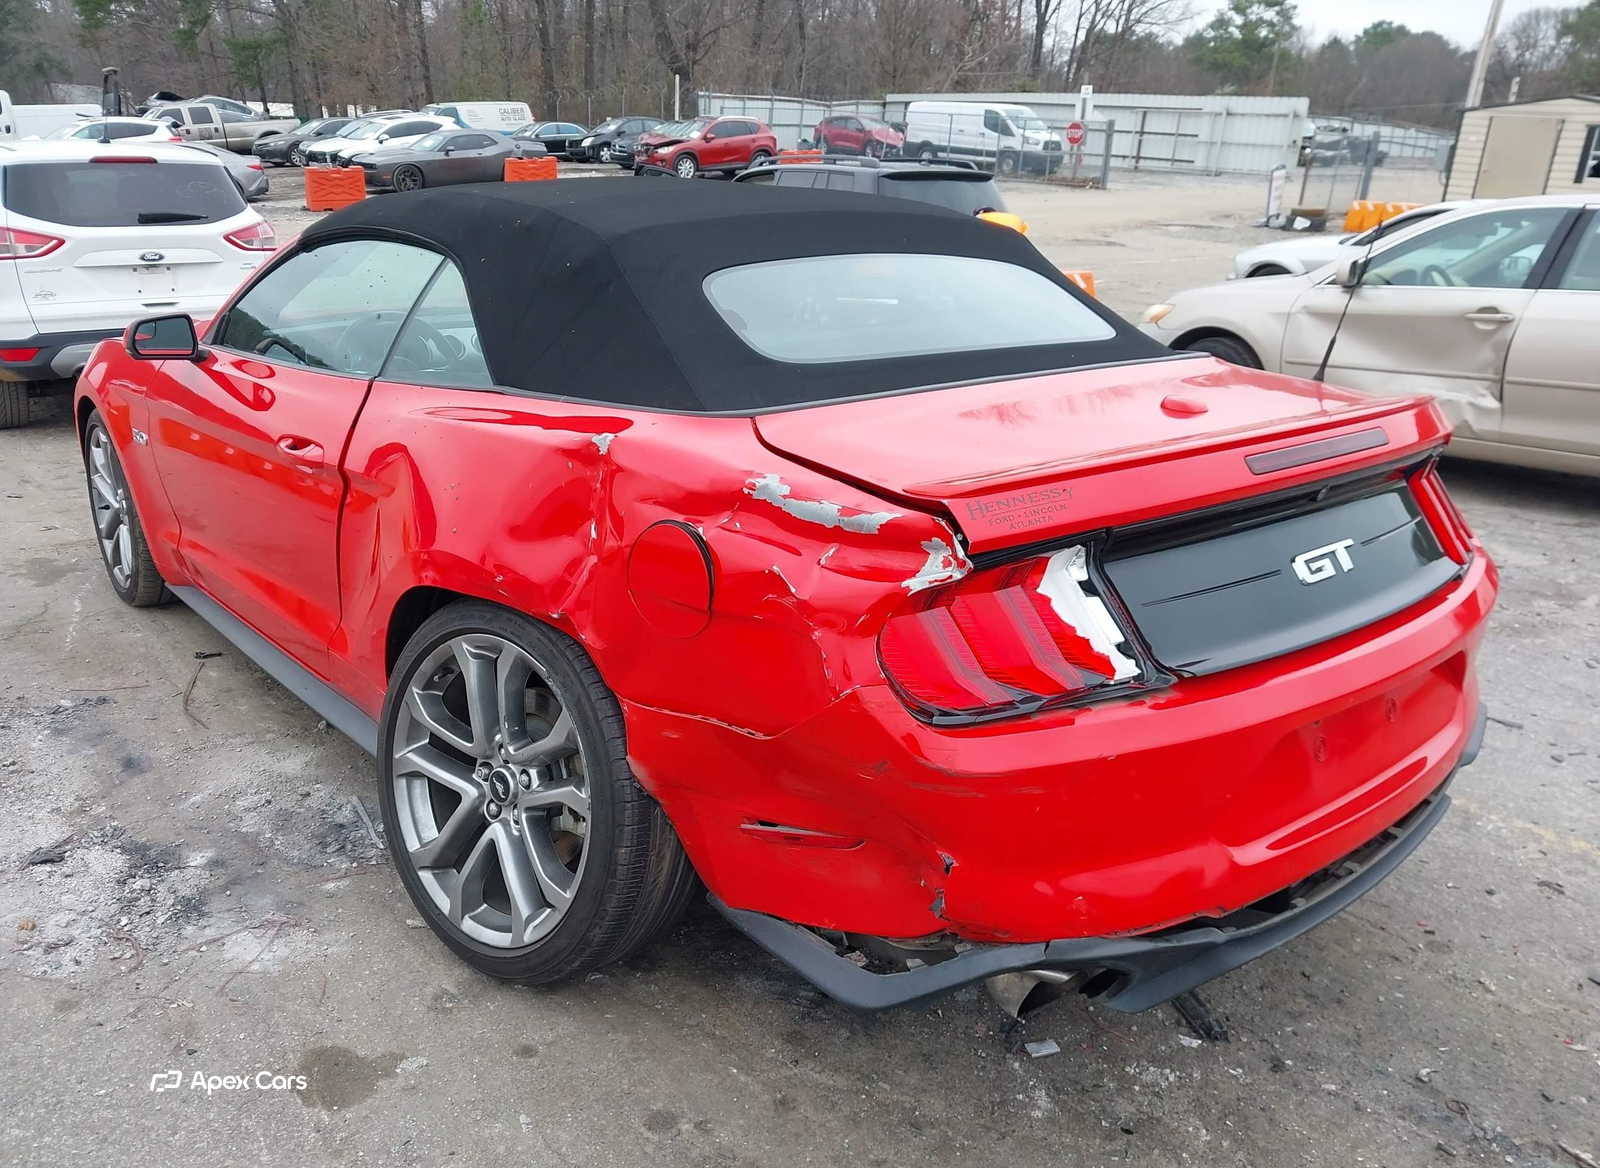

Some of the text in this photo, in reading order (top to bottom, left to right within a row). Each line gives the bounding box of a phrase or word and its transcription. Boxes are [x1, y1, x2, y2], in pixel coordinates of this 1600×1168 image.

[498, 107, 525, 115] CALIBER
[1067, 128, 1084, 139] STOP
[988, 503, 1067, 526] FORD LINCOLN
[1009, 516, 1054, 530] ATLANTA
[1291, 538, 1355, 584] GT
